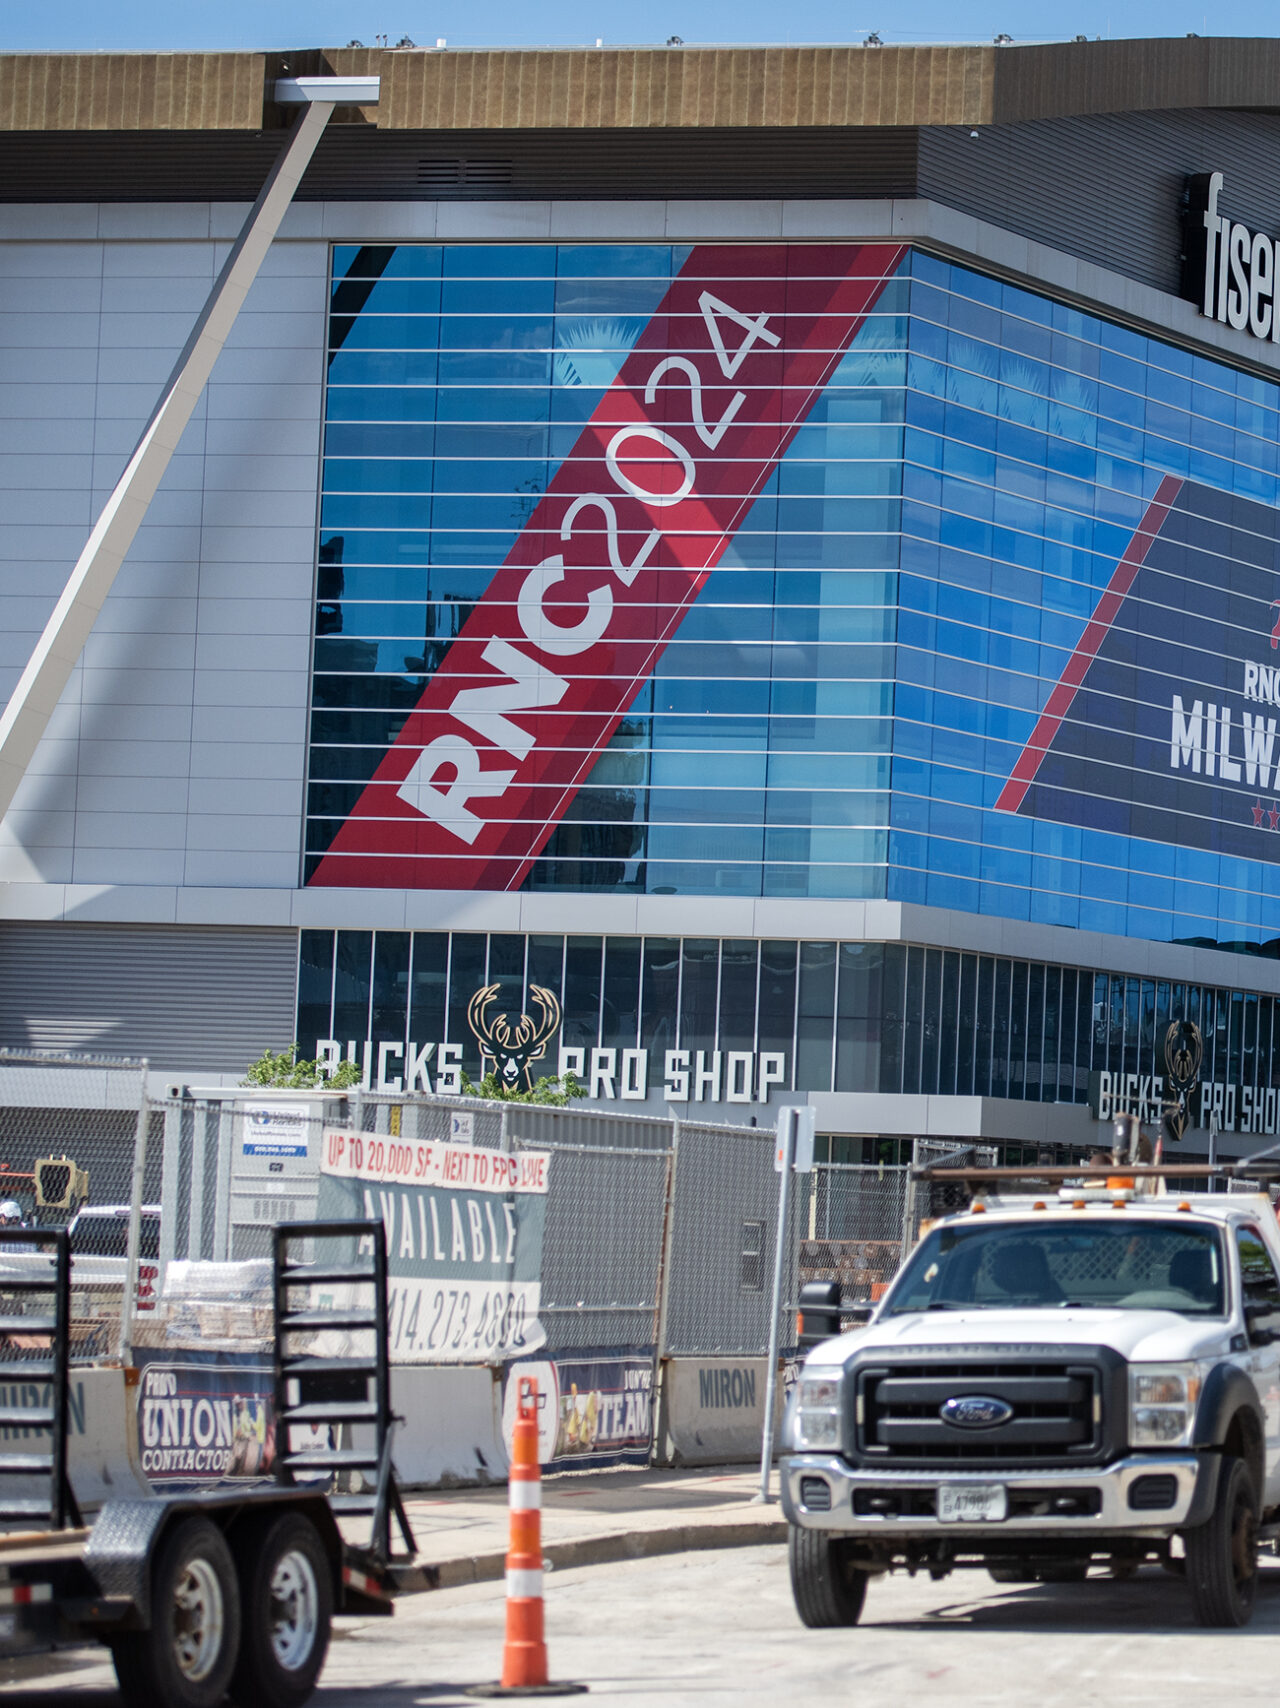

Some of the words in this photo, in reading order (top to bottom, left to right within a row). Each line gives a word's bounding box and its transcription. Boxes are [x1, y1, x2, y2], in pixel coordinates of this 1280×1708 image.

[396, 290, 781, 845] RNC2024
[316, 1040, 464, 1094] BUCKS
[560, 1047, 648, 1100] PRO
[664, 1049, 786, 1103] SHOP
[1099, 1070, 1163, 1124] BUCKS
[1200, 1081, 1236, 1131] PRO
[328, 1134, 345, 1167] UP
[349, 1138, 363, 1169] TO
[368, 1142, 413, 1178] 20,000
[415, 1146, 432, 1177] SF
[442, 1150, 470, 1182] NEXT
[473, 1154, 487, 1184] TO
[491, 1156, 518, 1187] FPC
[358, 1189, 517, 1264] AVAILABLE
[700, 1368, 755, 1408] MIRON
[956, 1401, 994, 1421] Ford
[143, 1399, 233, 1446] UNION
